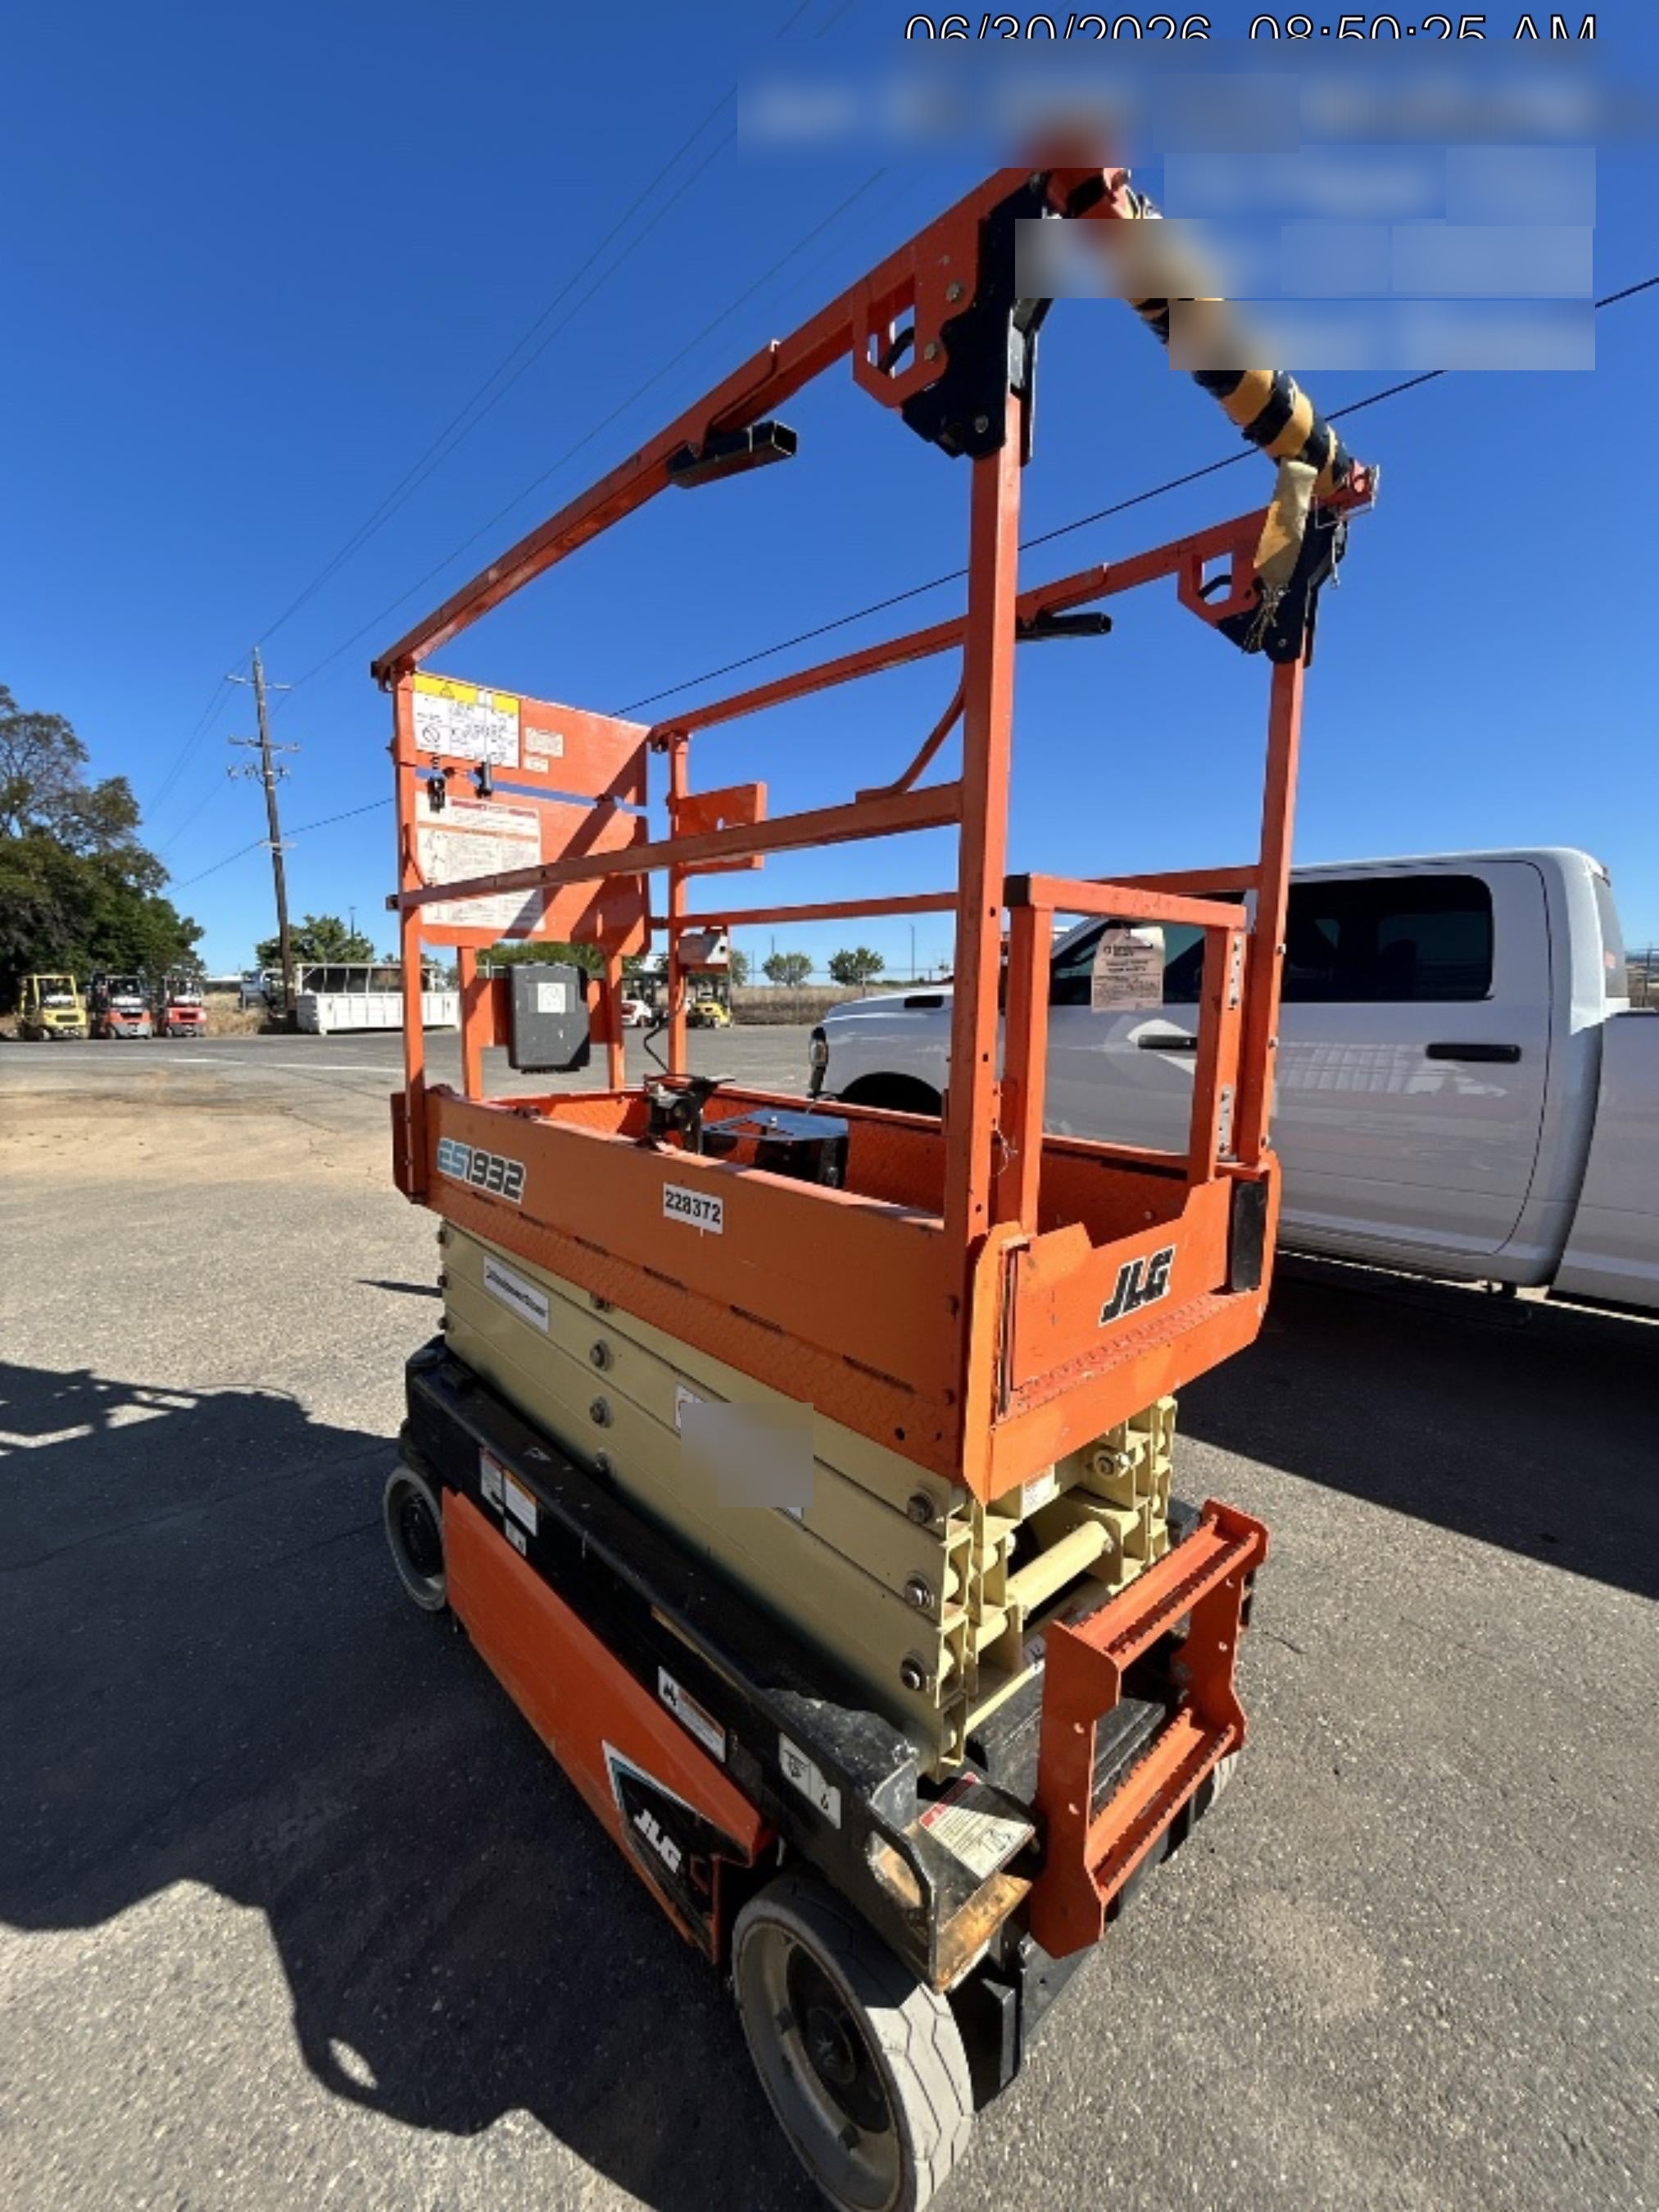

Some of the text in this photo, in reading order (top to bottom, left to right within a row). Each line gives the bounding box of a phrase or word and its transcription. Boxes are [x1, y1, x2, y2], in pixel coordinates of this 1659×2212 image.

[438, 1138, 525, 1203] ES1932
[665, 1189, 721, 1224] 228372
[1099, 1244, 1176, 1326] JLG
[633, 1808, 682, 1874] JLG
